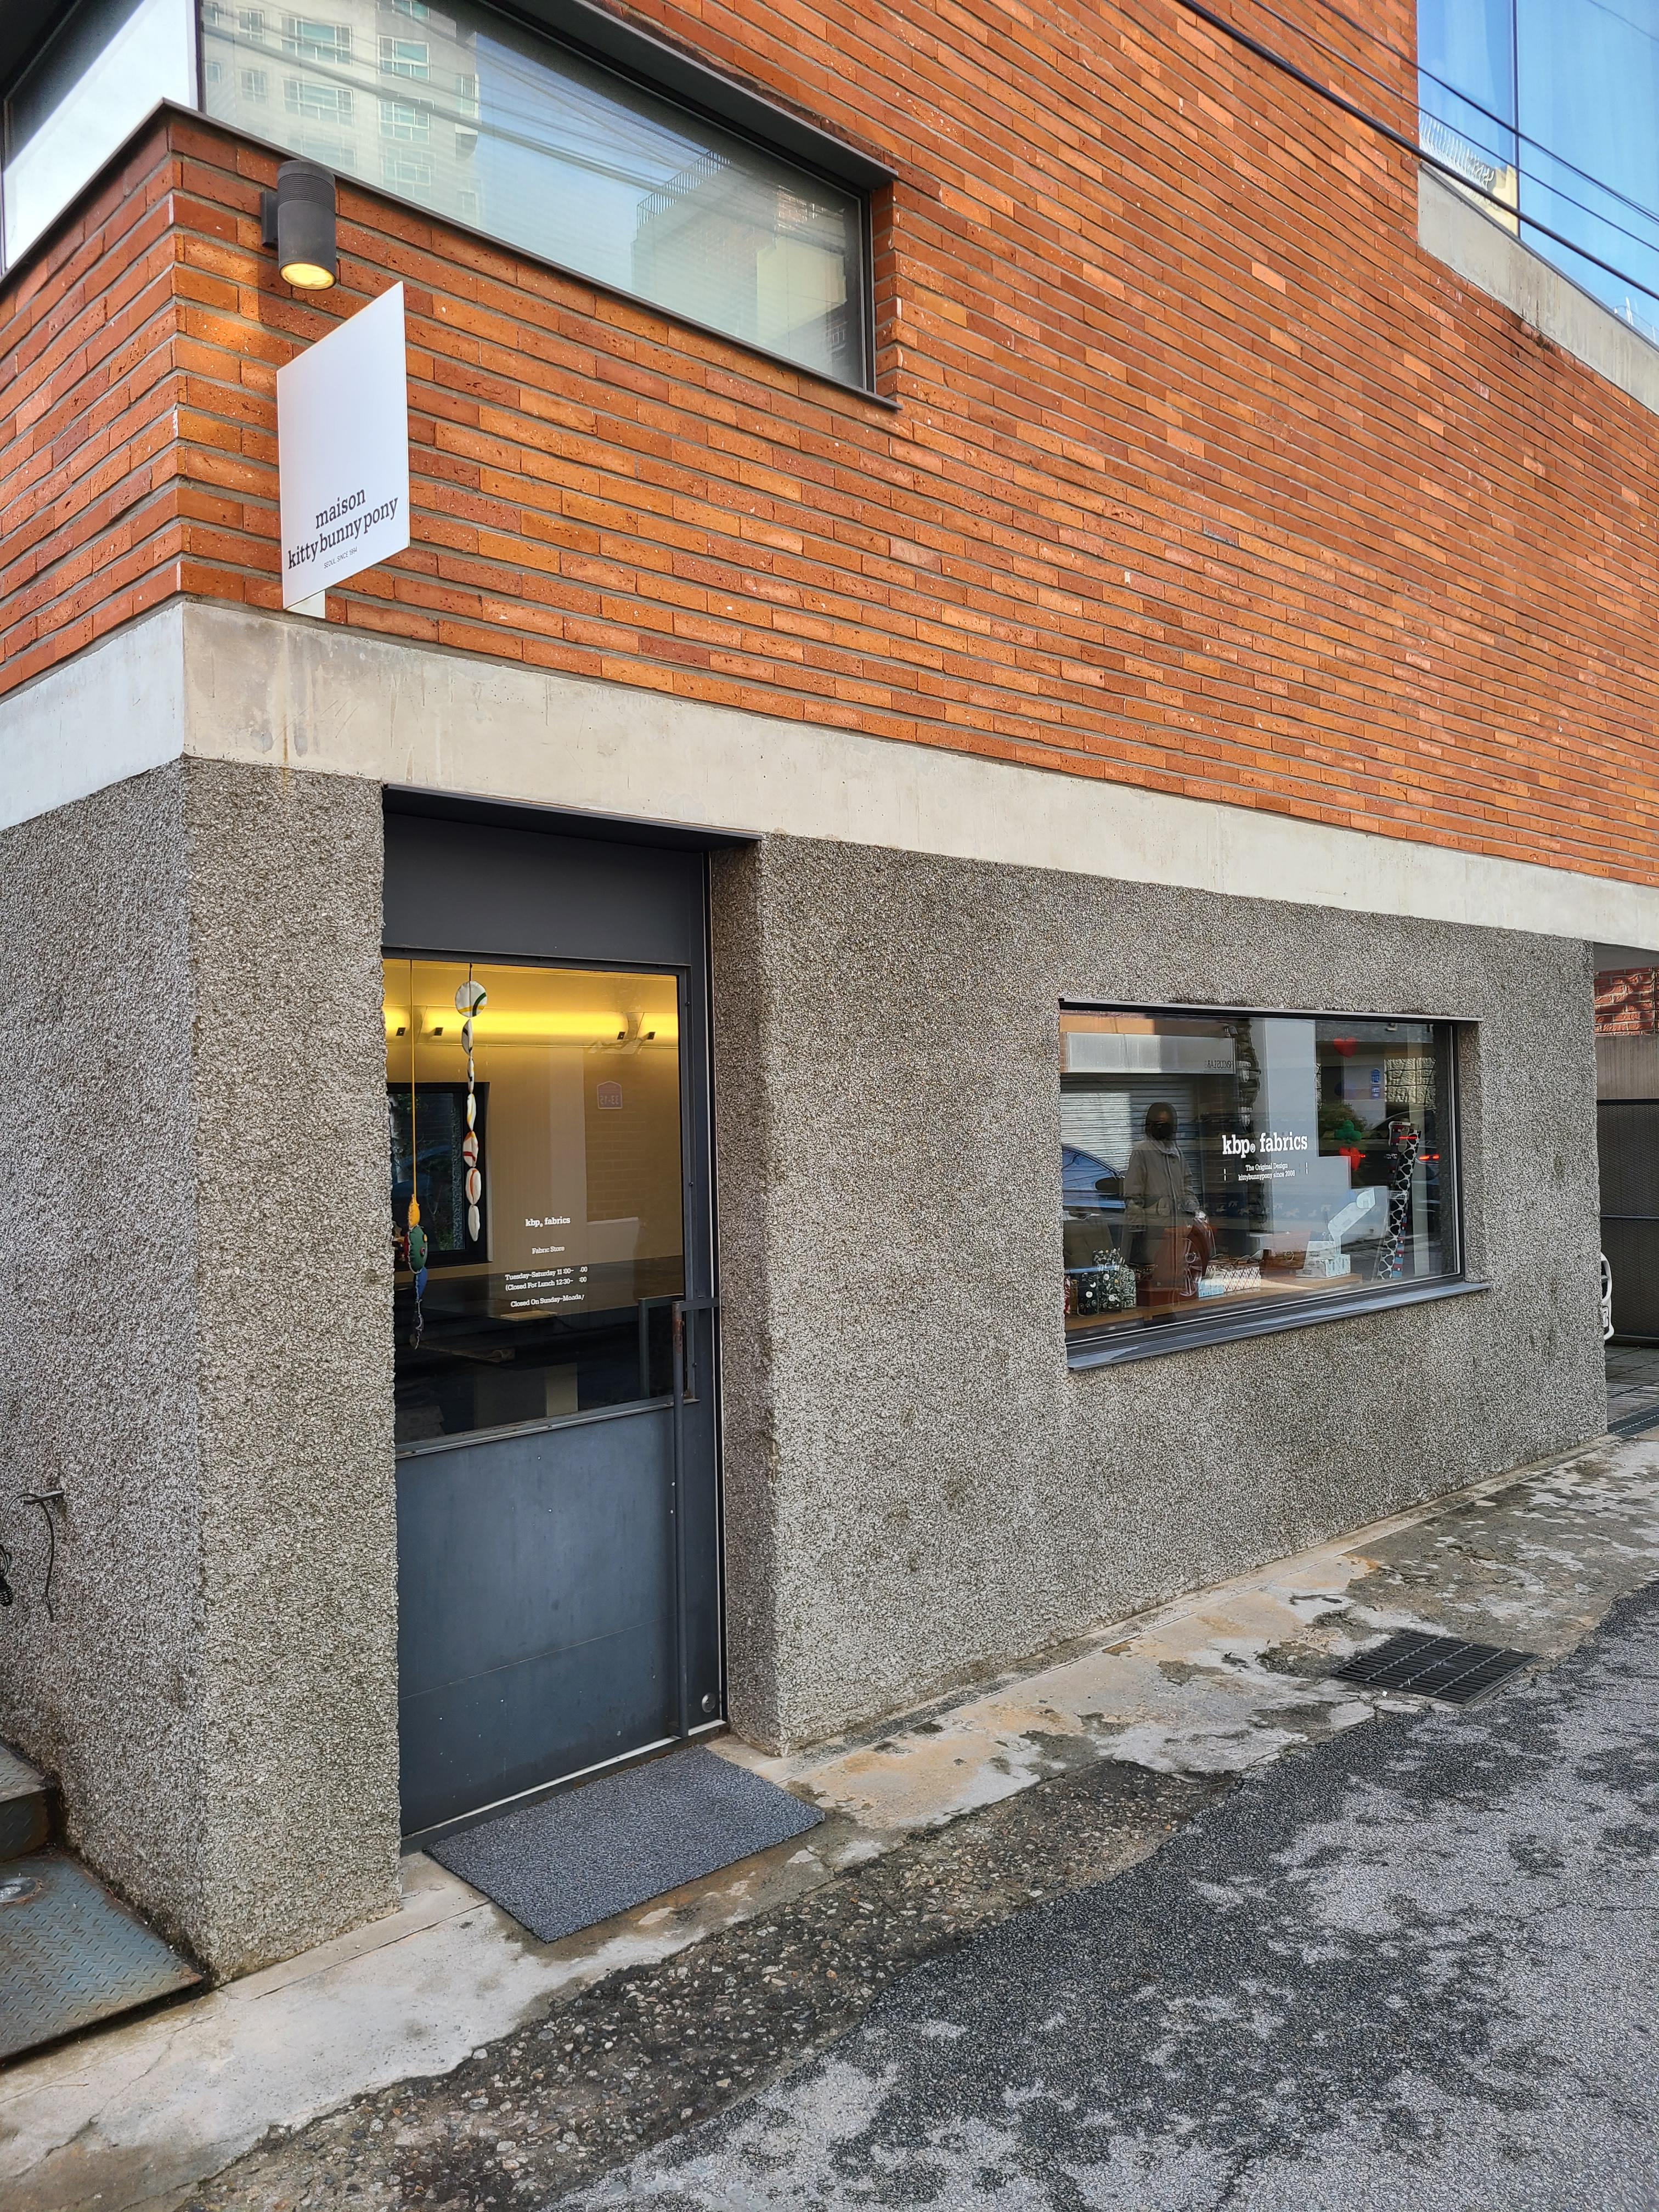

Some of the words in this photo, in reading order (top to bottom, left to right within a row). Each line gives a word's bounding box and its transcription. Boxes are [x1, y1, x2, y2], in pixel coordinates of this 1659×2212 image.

[315, 489, 366, 529] maison
[337, 551, 348, 562] SINCE
[1260, 1131, 1308, 1153] fabrics
[1255, 1163, 1273, 1171] Original
[1273, 1162, 1288, 1170] Design
[1238, 1173, 1273, 1182] kittybunnypony
[544, 1216, 571, 1225] fabrics
[510, 1299, 530, 1307] Closed
